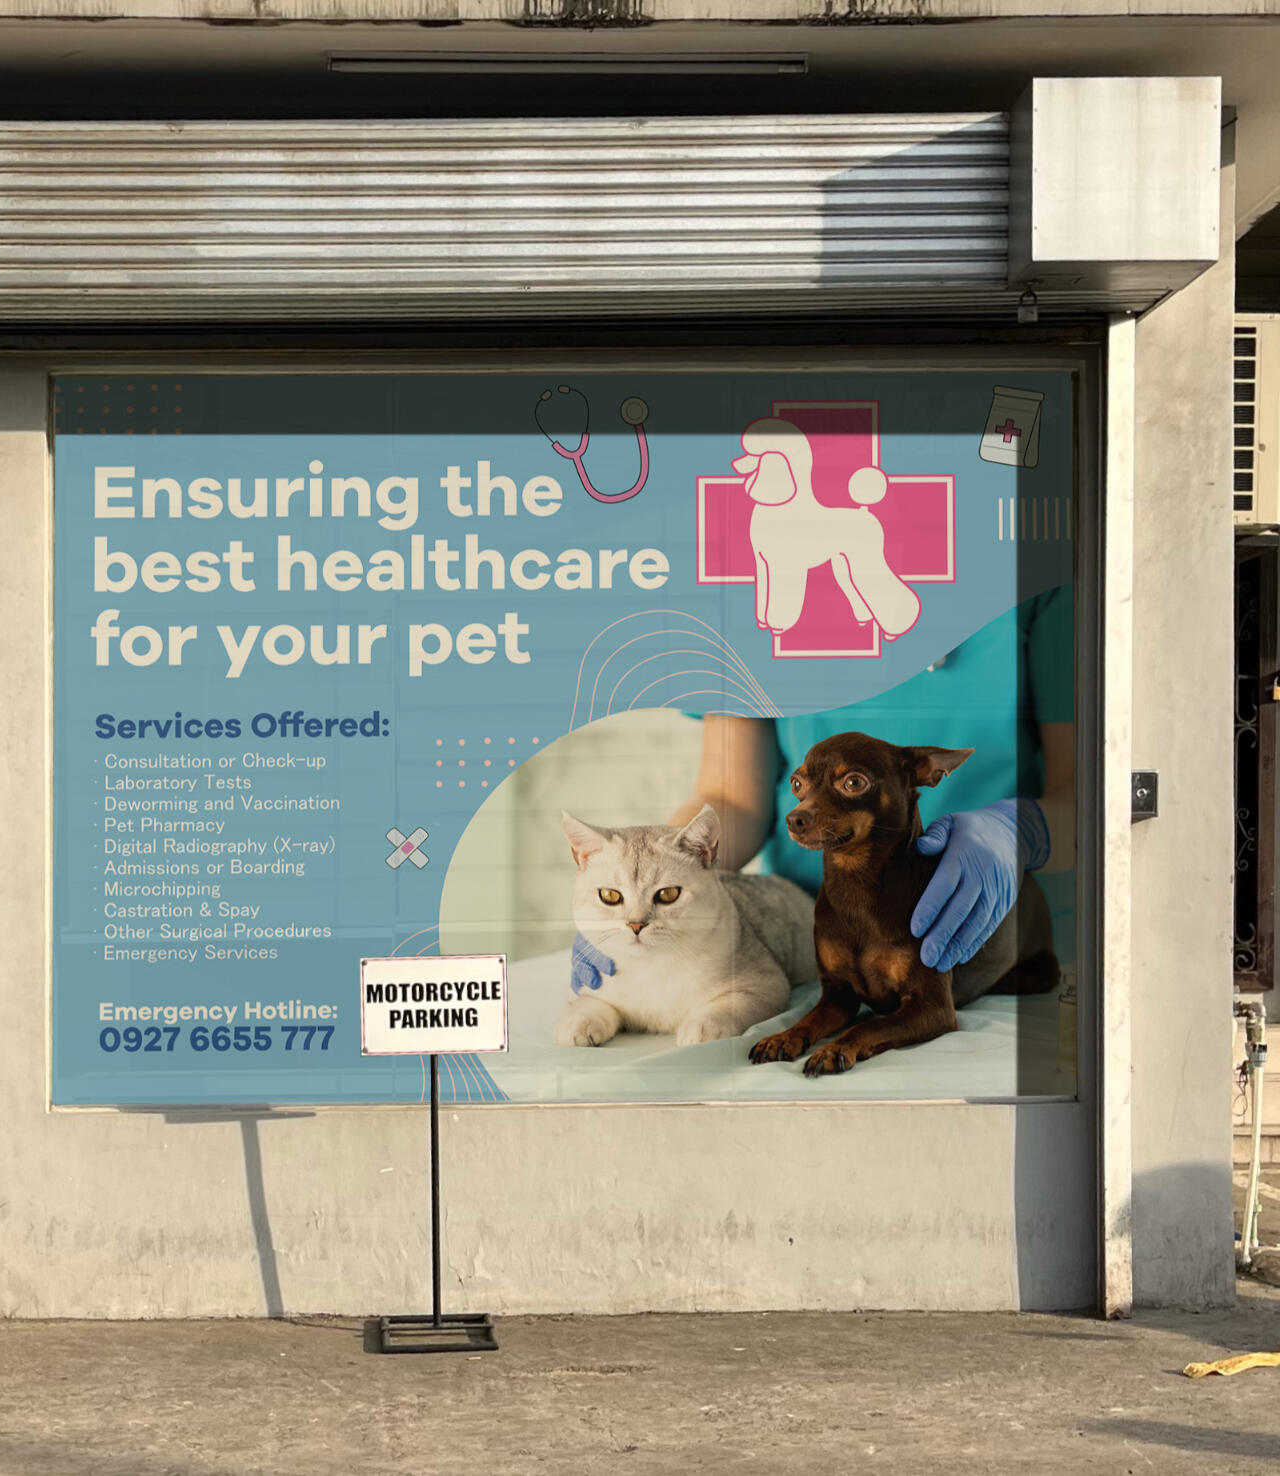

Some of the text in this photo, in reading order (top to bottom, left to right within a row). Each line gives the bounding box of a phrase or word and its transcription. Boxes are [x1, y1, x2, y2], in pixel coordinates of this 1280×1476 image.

[94, 460, 564, 531] Ensuring the
[93, 534, 671, 593] best healthcare
[91, 608, 531, 679] for your pet
[95, 711, 390, 739] Services Offered:
[105, 752, 326, 770] Consultation or Check-up
[105, 774, 252, 792] Laboratory Tests
[104, 795, 340, 813] Deworming and Vaccination
[104, 817, 225, 834] Pet Pharmacy
[104, 835, 336, 856] Digital Radiography (X-ray)
[104, 859, 305, 877] Admissions or Boarding
[104, 881, 221, 898] Microchipping
[104, 901, 260, 919] Castration & Spay
[104, 921, 332, 941] Other Surgical Procedures
[104, 944, 278, 963] Emergency Services
[366, 981, 501, 1003] MOTORCYCLE
[98, 999, 338, 1026] Emergency Hotline:
[389, 1007, 478, 1029] PARKING
[99, 1025, 335, 1054] 0927 6655 777
